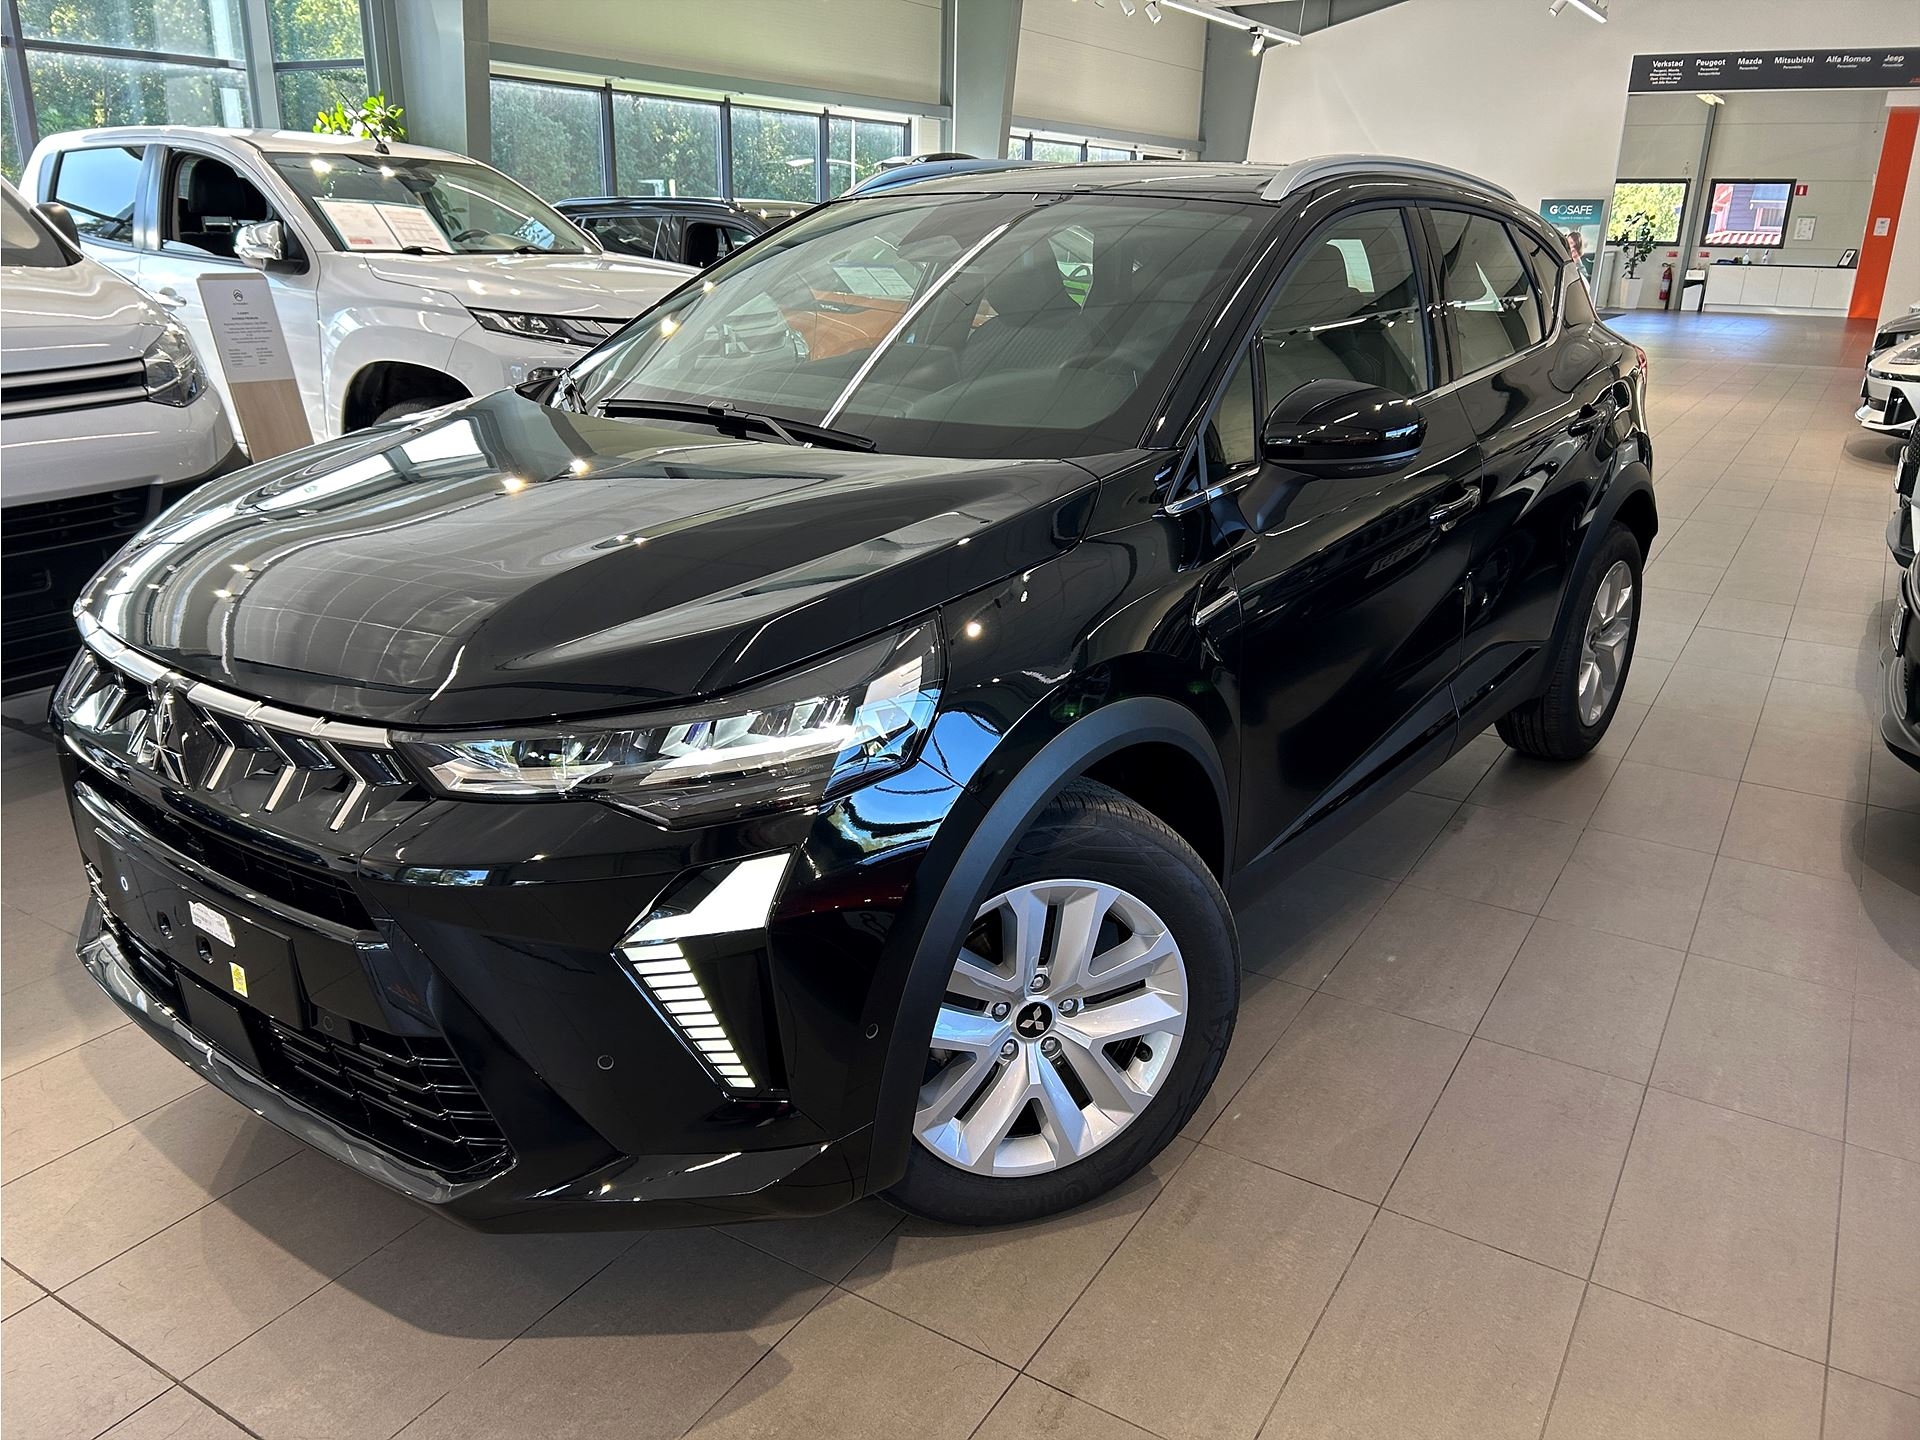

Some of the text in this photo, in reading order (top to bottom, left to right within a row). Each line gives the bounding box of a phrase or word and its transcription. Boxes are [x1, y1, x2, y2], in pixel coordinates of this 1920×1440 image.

[1774, 56, 1815, 64] Mitsubishi
[1825, 55, 1871, 63] Alfa Romeo
[1884, 54, 1905, 62] Jeep
[1696, 58, 1726, 67] Peugeot
[1550, 205, 1593, 215] GOSAFE
